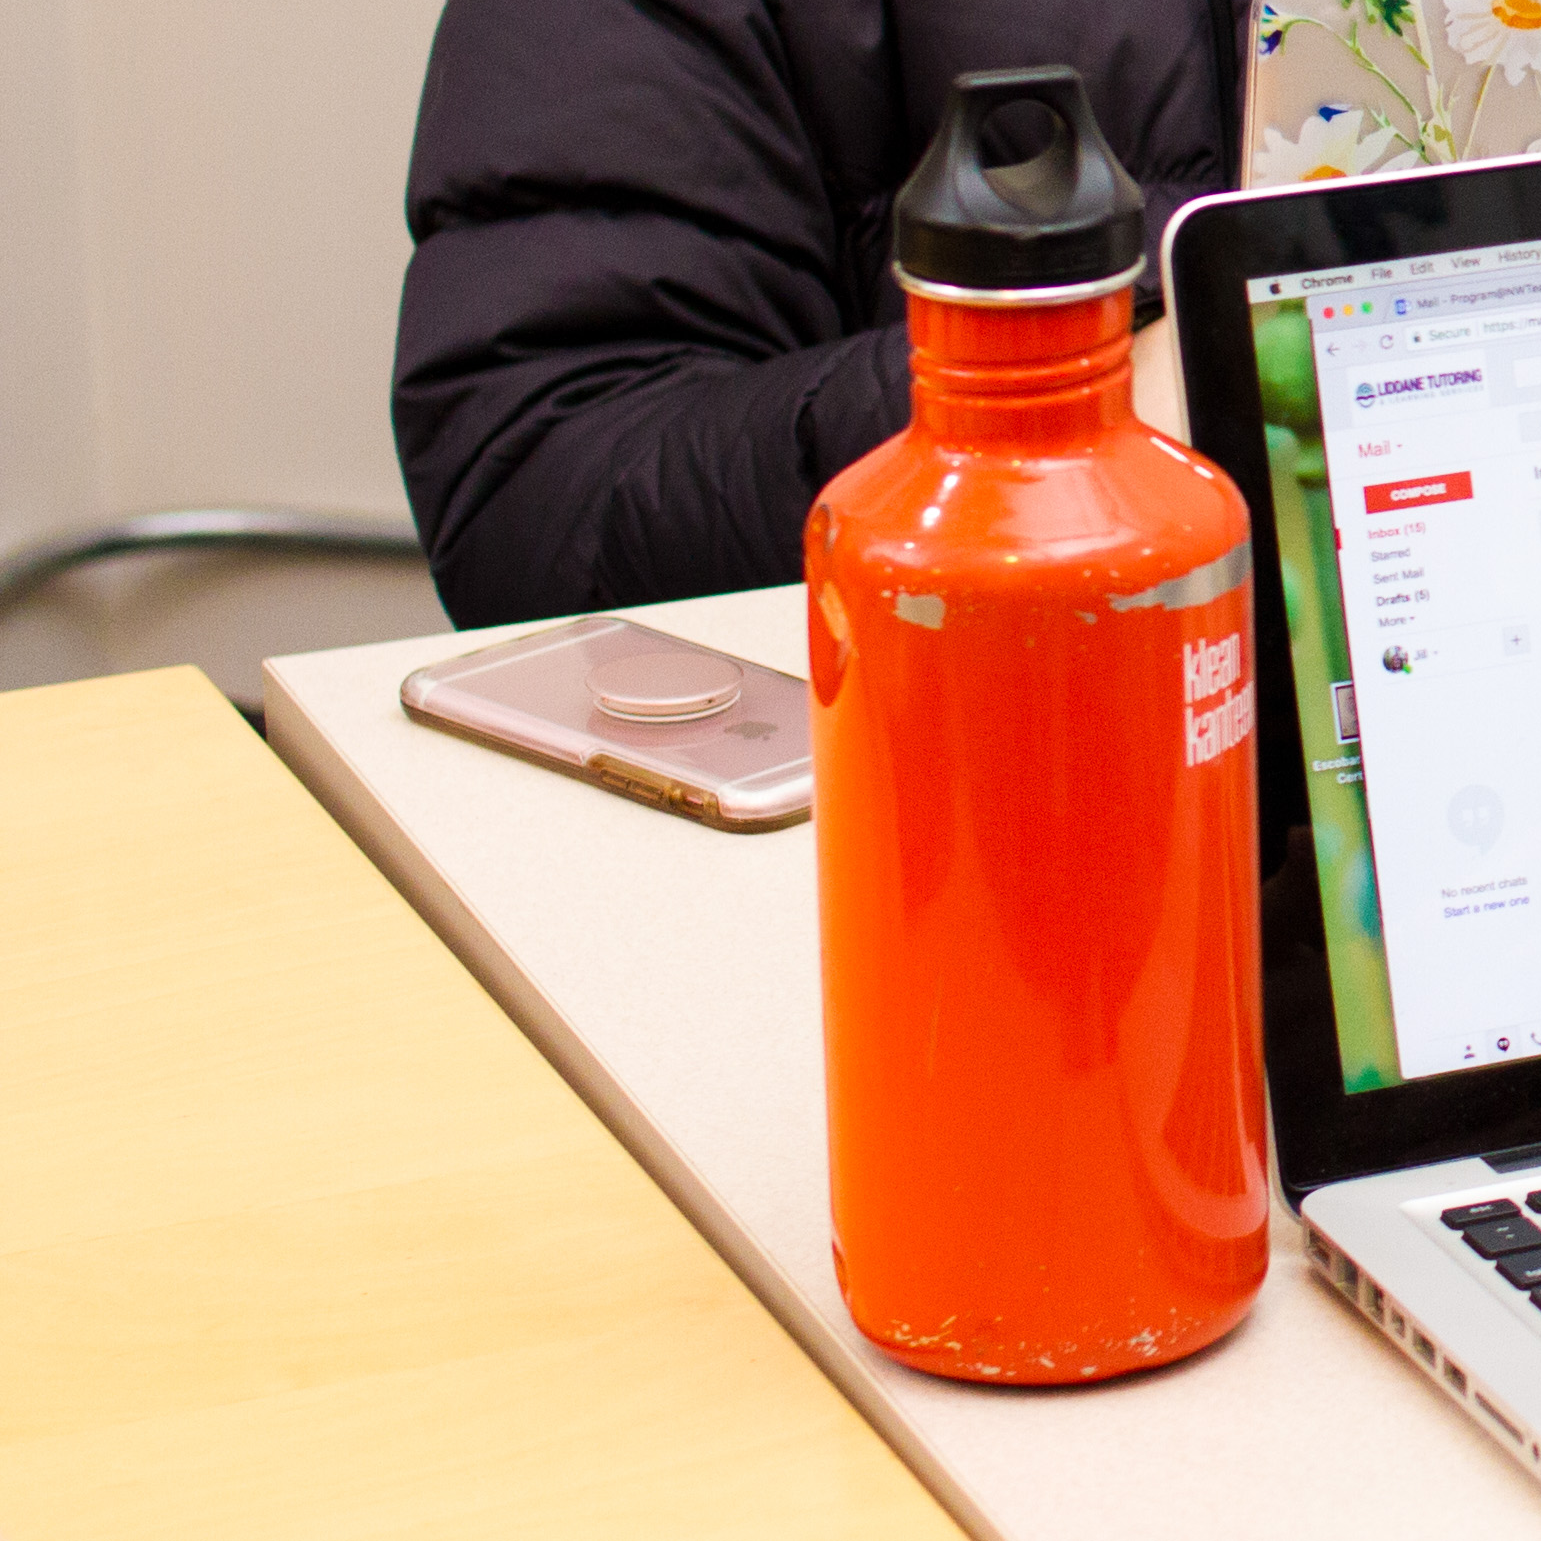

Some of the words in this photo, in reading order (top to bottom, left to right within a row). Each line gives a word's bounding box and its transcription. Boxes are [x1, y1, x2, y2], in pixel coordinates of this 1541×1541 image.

[1301, 274, 1354, 290] Chrome
[1371, 266, 1393, 279] File
[1409, 261, 1434, 276] Edit
[1450, 257, 1481, 269] View
[1498, 249, 1541, 262] History
[1428, 327, 1471, 342] Secure
[1426, 368, 1482, 388] TUTORING
[1357, 441, 1391, 458] Mail
[1367, 527, 1401, 540] Inbox
[1403, 521, 1426, 536] (15)
[1370, 548, 1411, 563] Starred
[1373, 572, 1398, 585] Sent
[1401, 568, 1424, 580] Mail
[1376, 593, 1411, 607] Drafts
[1414, 589, 1430, 602] (5)
[1377, 616, 1407, 628] More
[1183, 633, 1241, 705] klean
